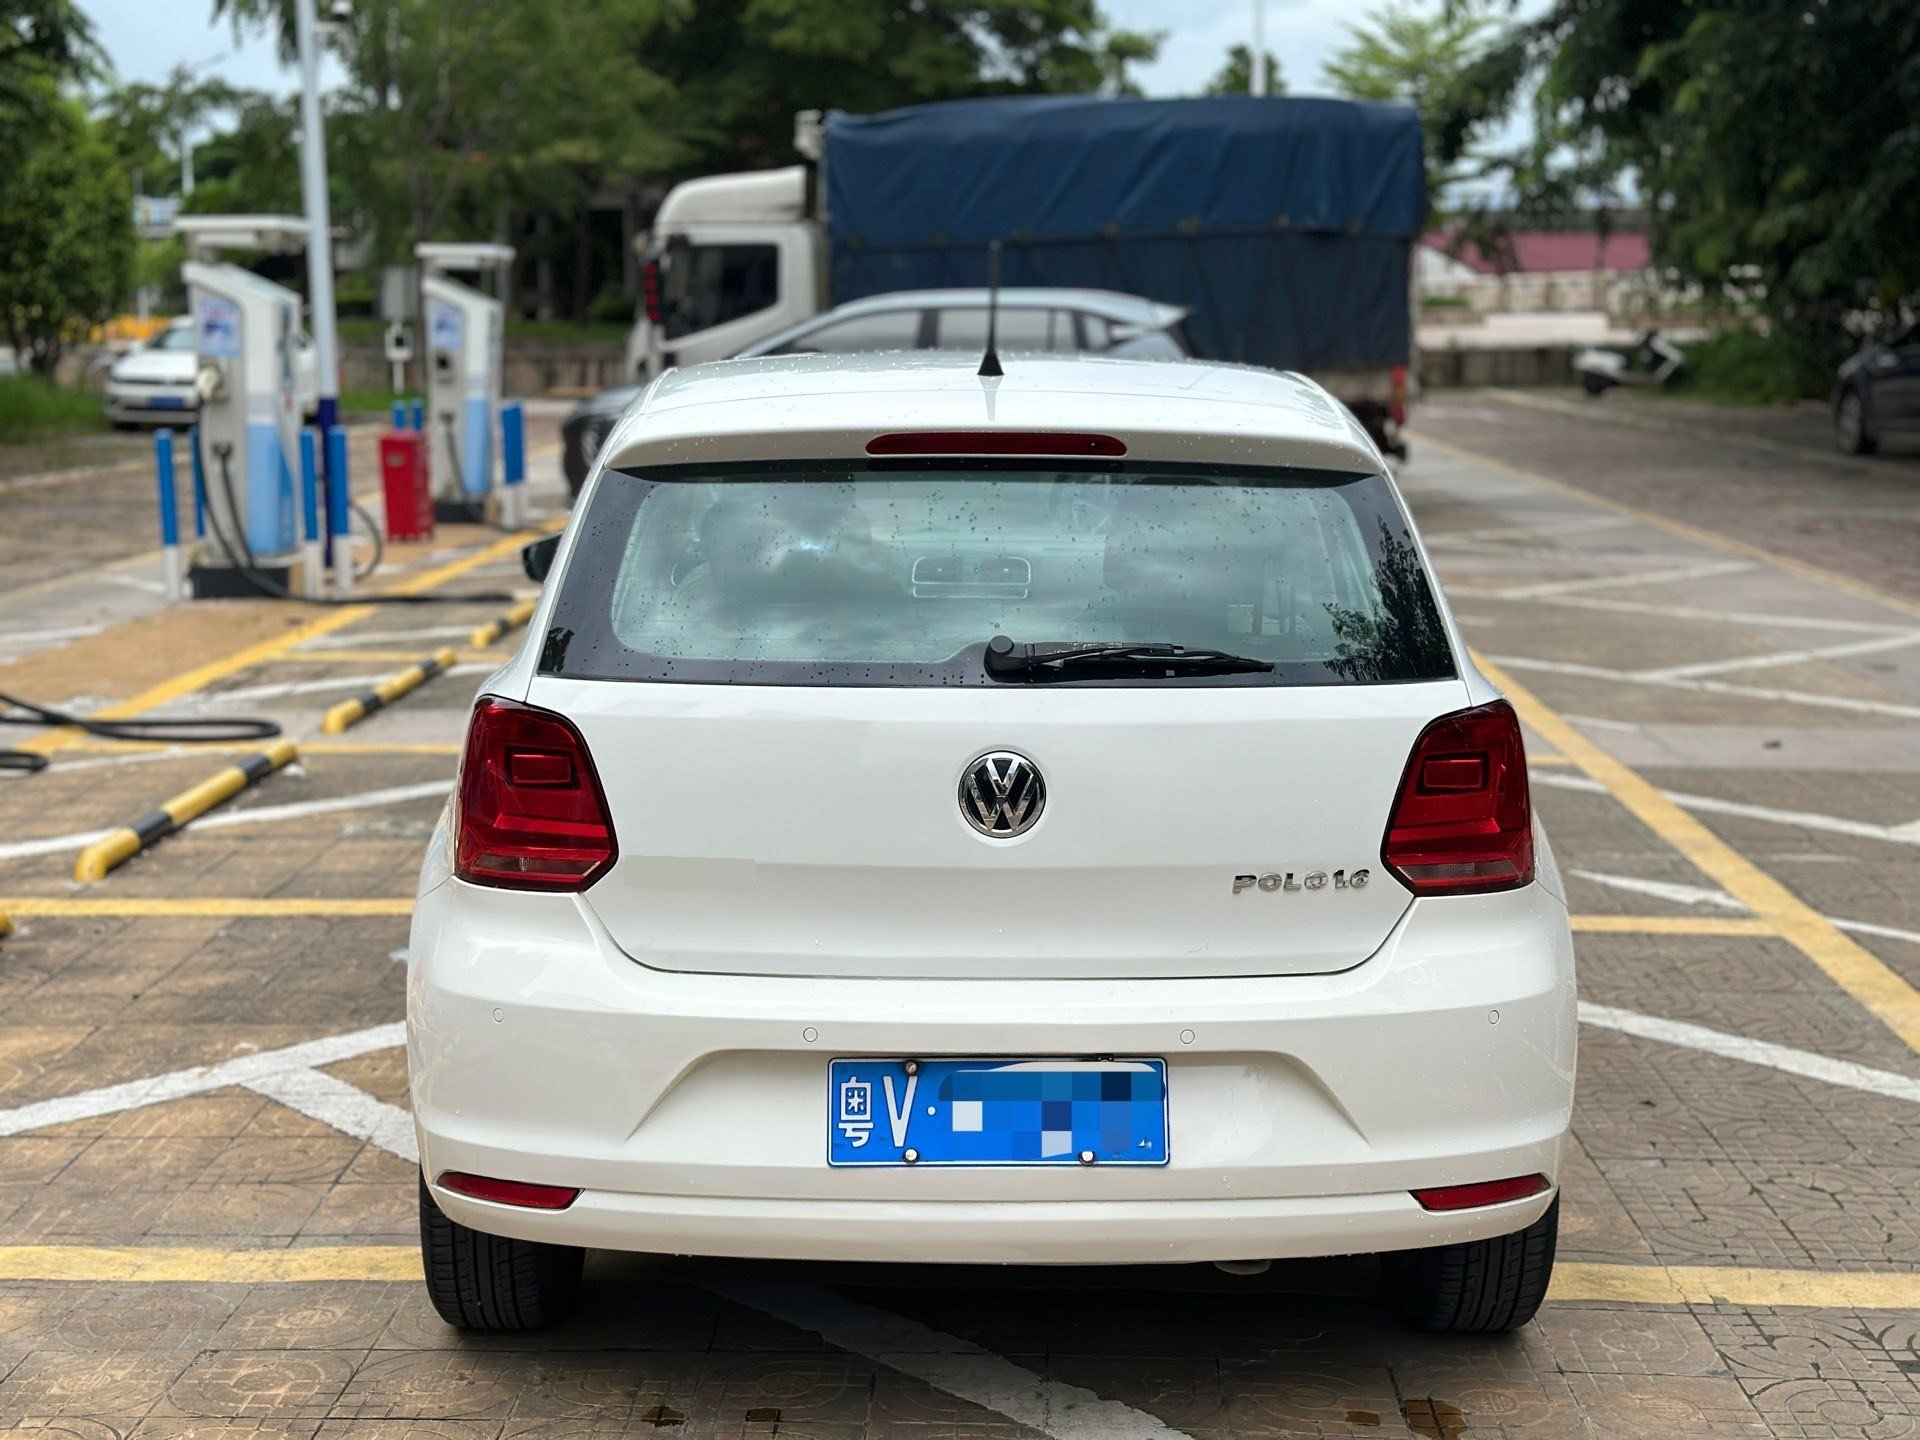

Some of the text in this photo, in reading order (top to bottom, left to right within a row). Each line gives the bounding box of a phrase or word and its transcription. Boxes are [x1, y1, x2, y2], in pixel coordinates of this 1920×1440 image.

[962, 753, 1040, 834] VW
[1232, 869, 1370, 894] POLO 1.6
